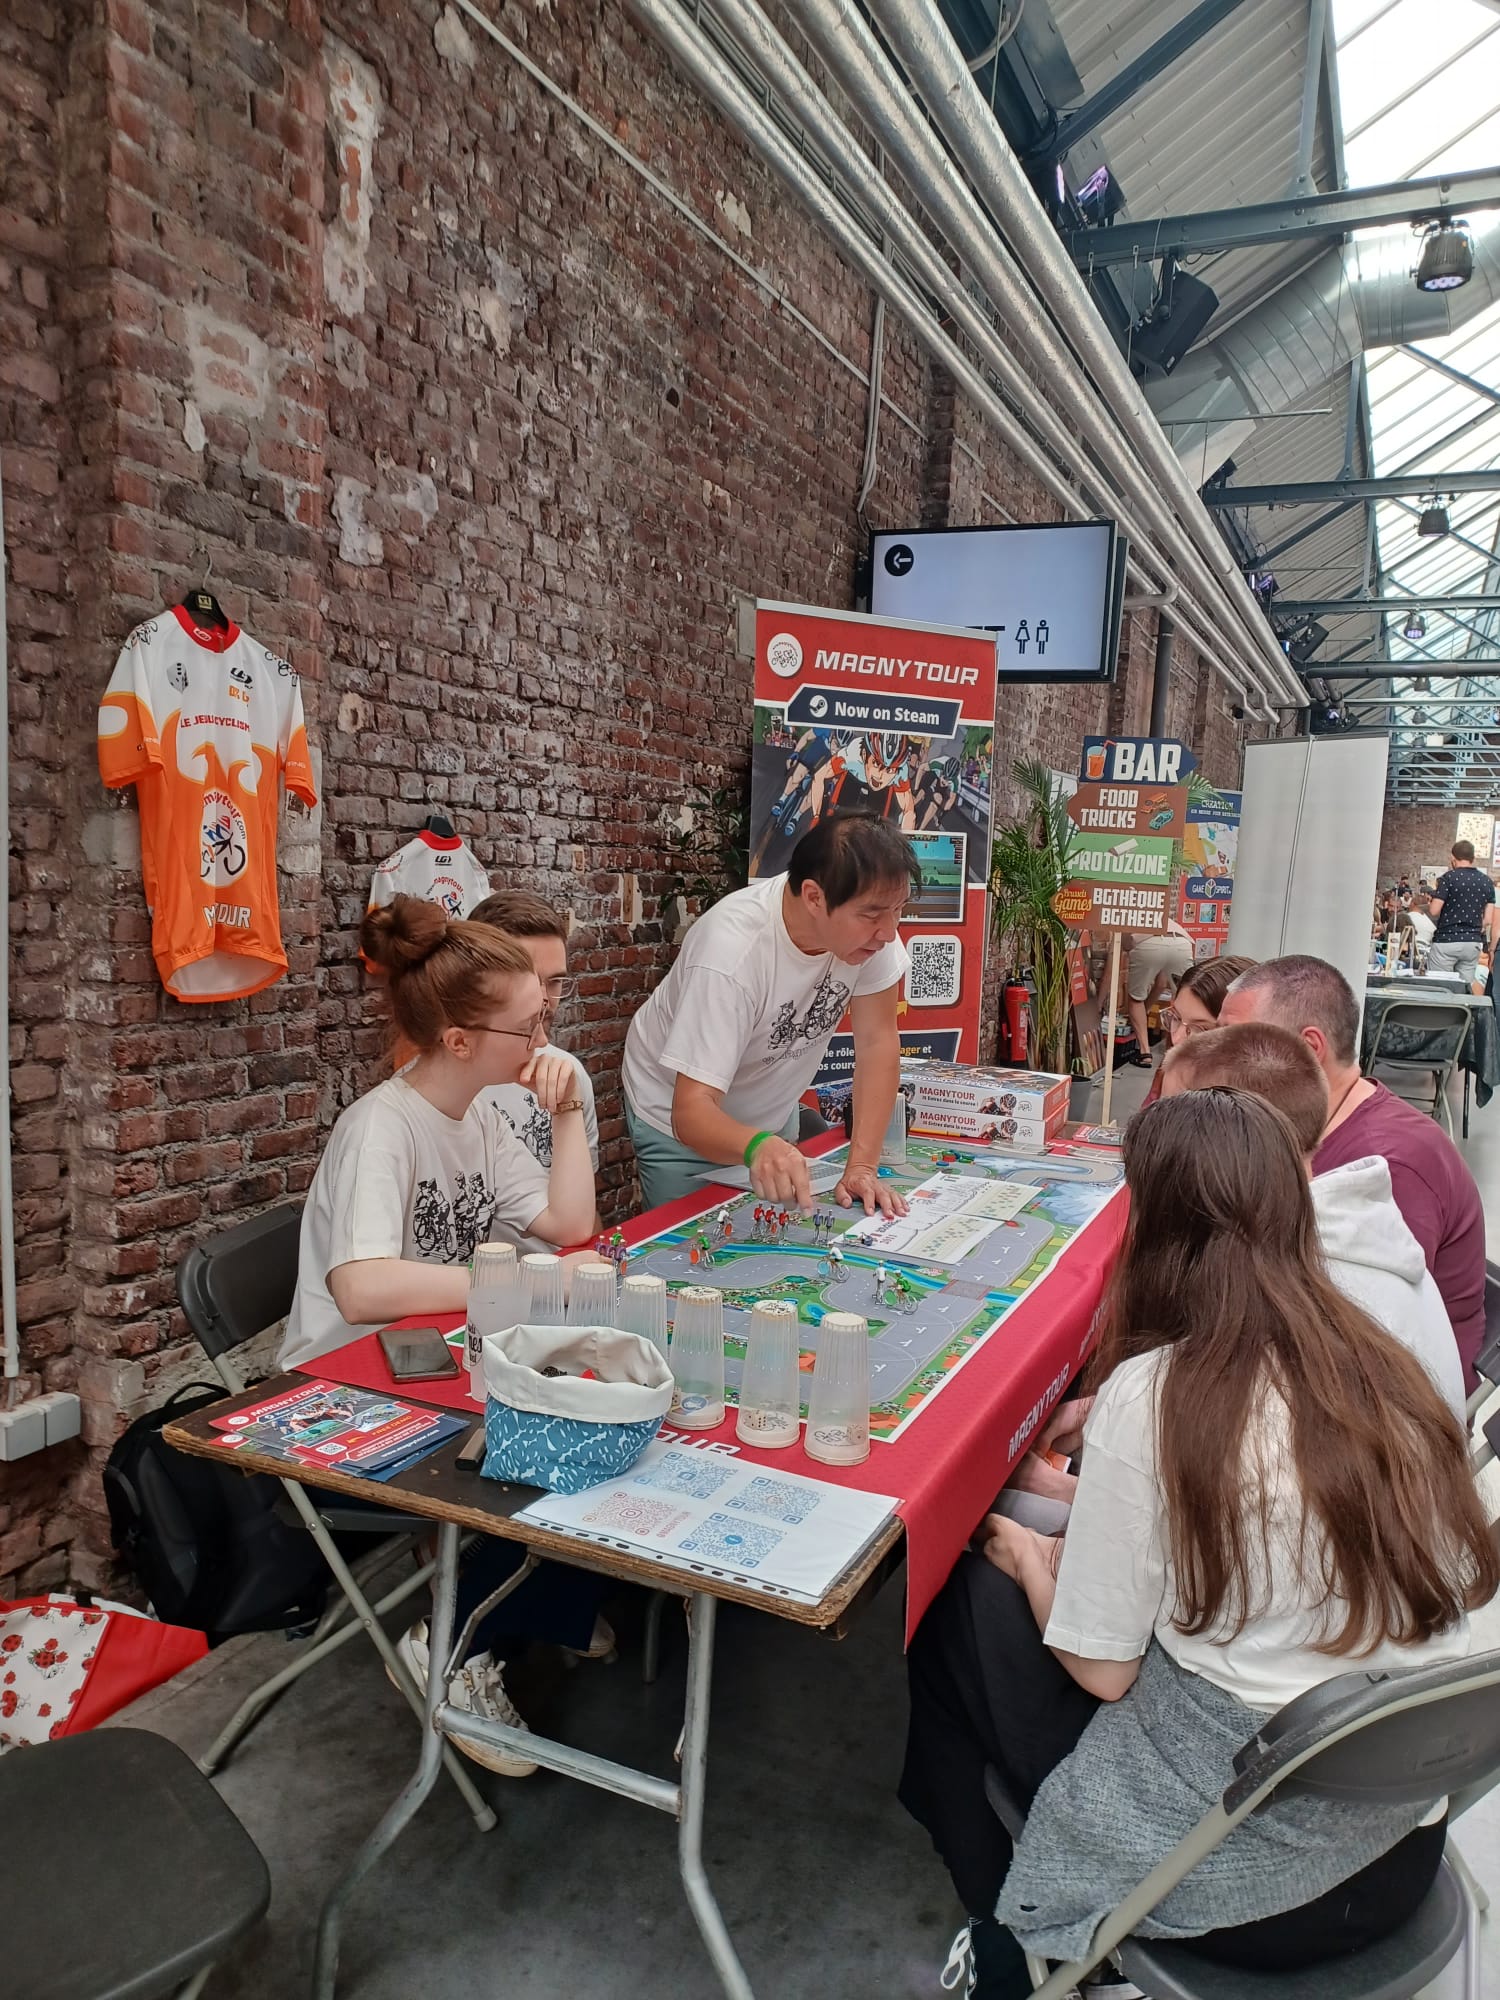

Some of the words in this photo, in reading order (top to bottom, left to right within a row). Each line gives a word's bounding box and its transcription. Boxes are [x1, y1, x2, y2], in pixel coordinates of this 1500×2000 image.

[814, 649, 980, 686] MAGNYTOUR
[834, 701, 868, 719] Now
[873, 709, 891, 721] on
[895, 707, 940, 725] Steam
[1112, 742, 1182, 783] BAR
[1098, 788, 1139, 808] FOOD
[1080, 808, 1137, 829] TRUCKS
[1067, 850, 1168, 876] PROTOZONE
[1093, 886, 1166, 909] BGTHÈQUE
[1191, 884, 1205, 894] GAME
[1054, 892, 1092, 914] Games
[1101, 907, 1164, 929] BGTHEEK
[922, 1044, 932, 1054] et
[818, 1062, 829, 1071] os
[919, 1087, 975, 1101] MAGNYTOUR
[920, 1111, 976, 1126] MAGNYTOUR
[250, 1384, 326, 1417] MAGNYTOUR
[1007, 1362, 1070, 1463] MAGNYTOUR
